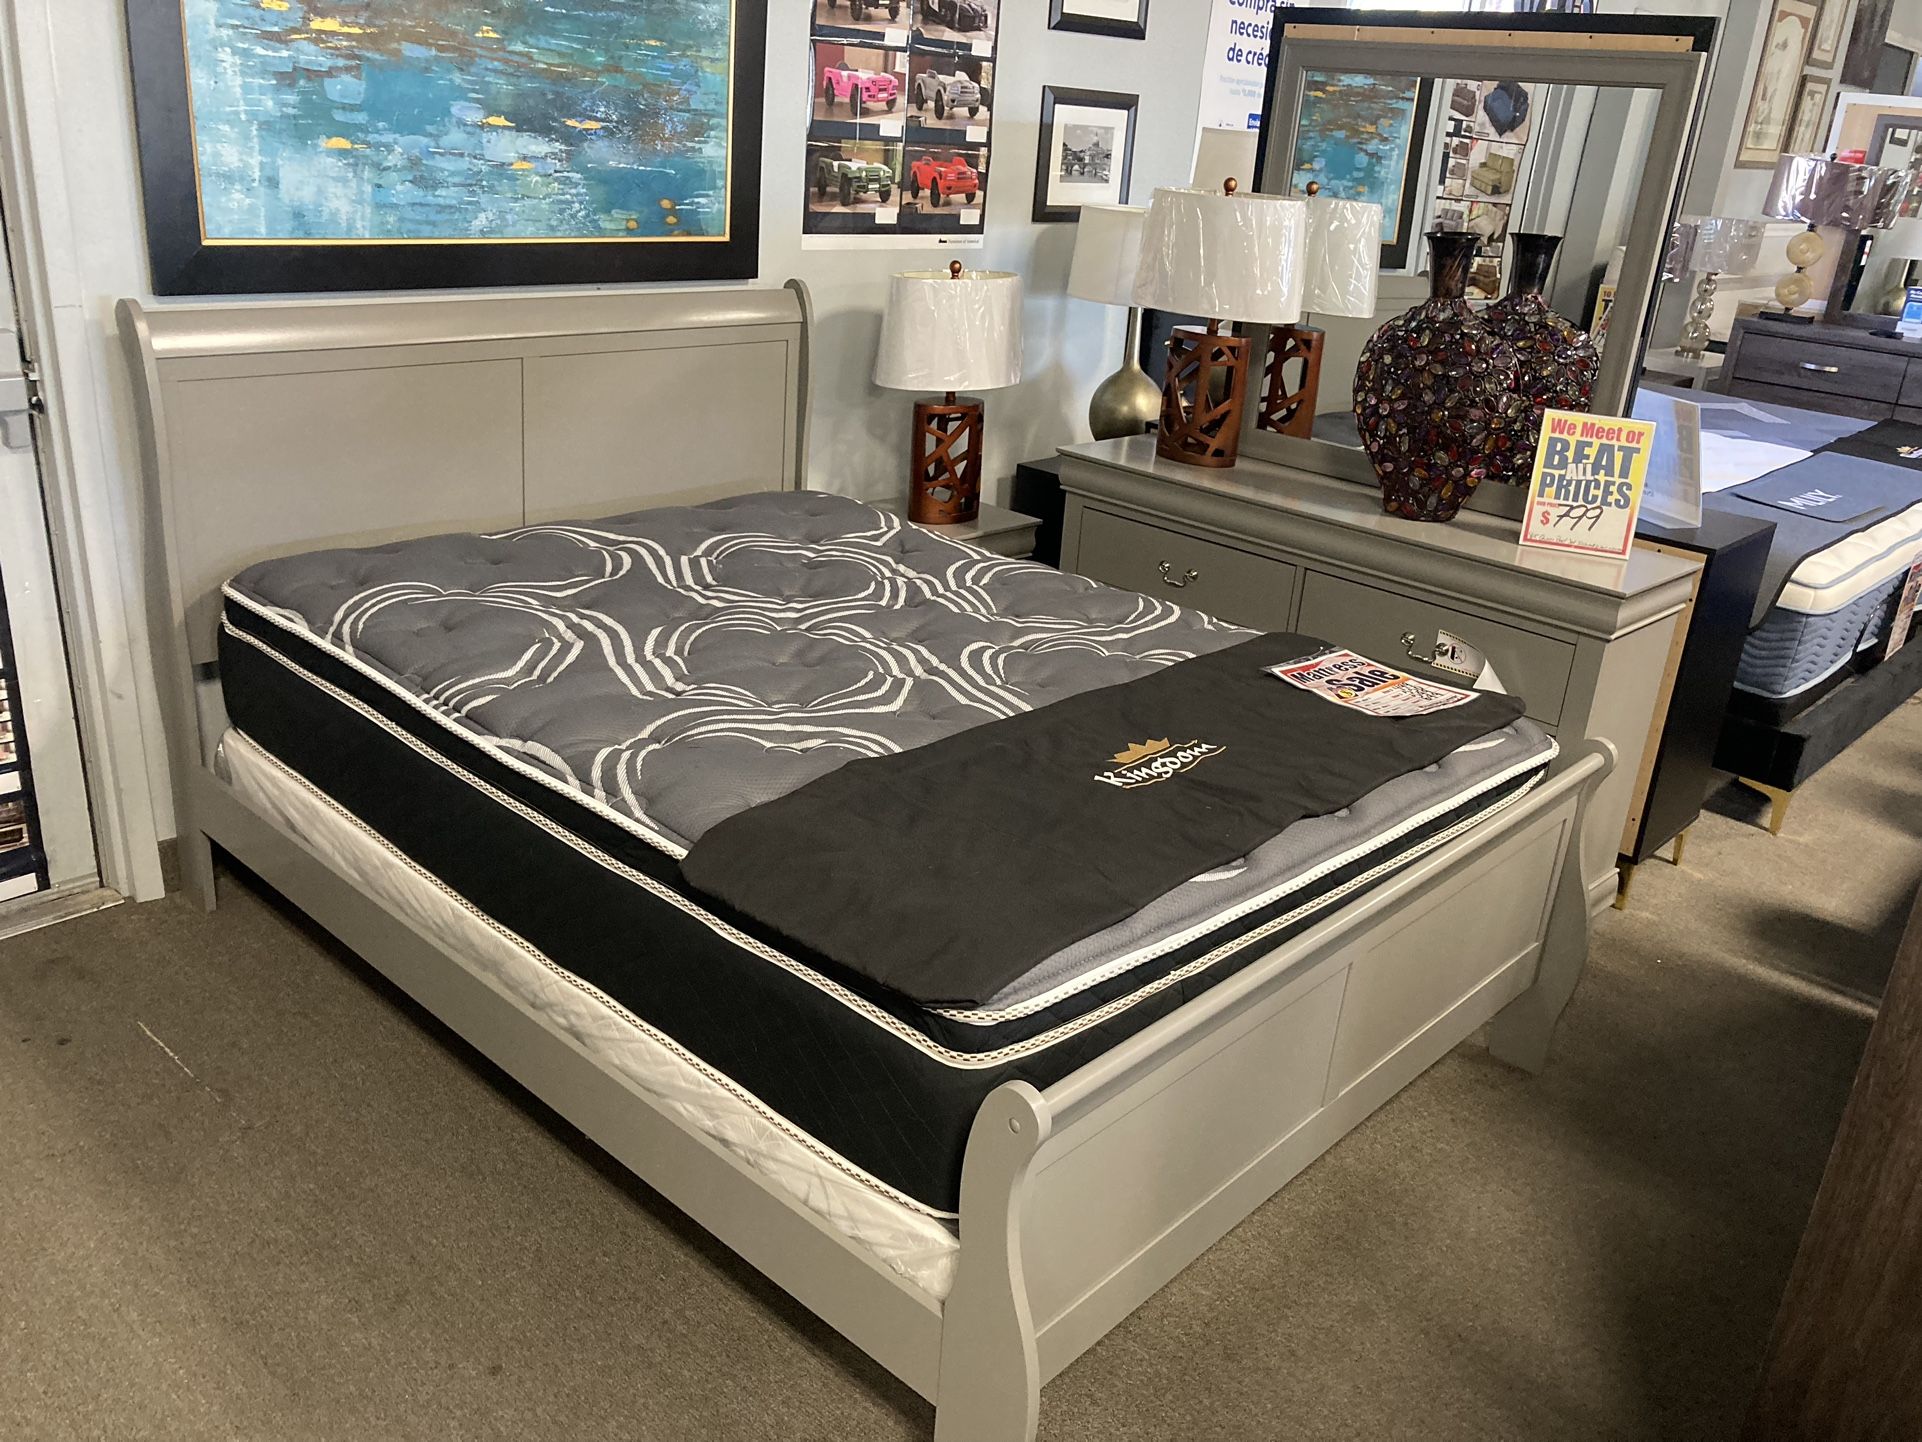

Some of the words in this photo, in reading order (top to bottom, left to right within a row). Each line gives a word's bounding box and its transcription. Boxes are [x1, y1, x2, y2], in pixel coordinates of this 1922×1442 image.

[1230, 19, 1273, 40] necesi
[1227, 42, 1244, 64] de
[1551, 418, 1577, 436] We
[1580, 422, 1623, 442] Meet
[1625, 429, 1645, 444] or
[1543, 436, 1641, 479] BEAT
[1565, 463, 1594, 480] ALL
[1537, 471, 1633, 509] PRICES
[1291, 658, 1366, 684] Mattress
[1324, 669, 1401, 692] Sale
